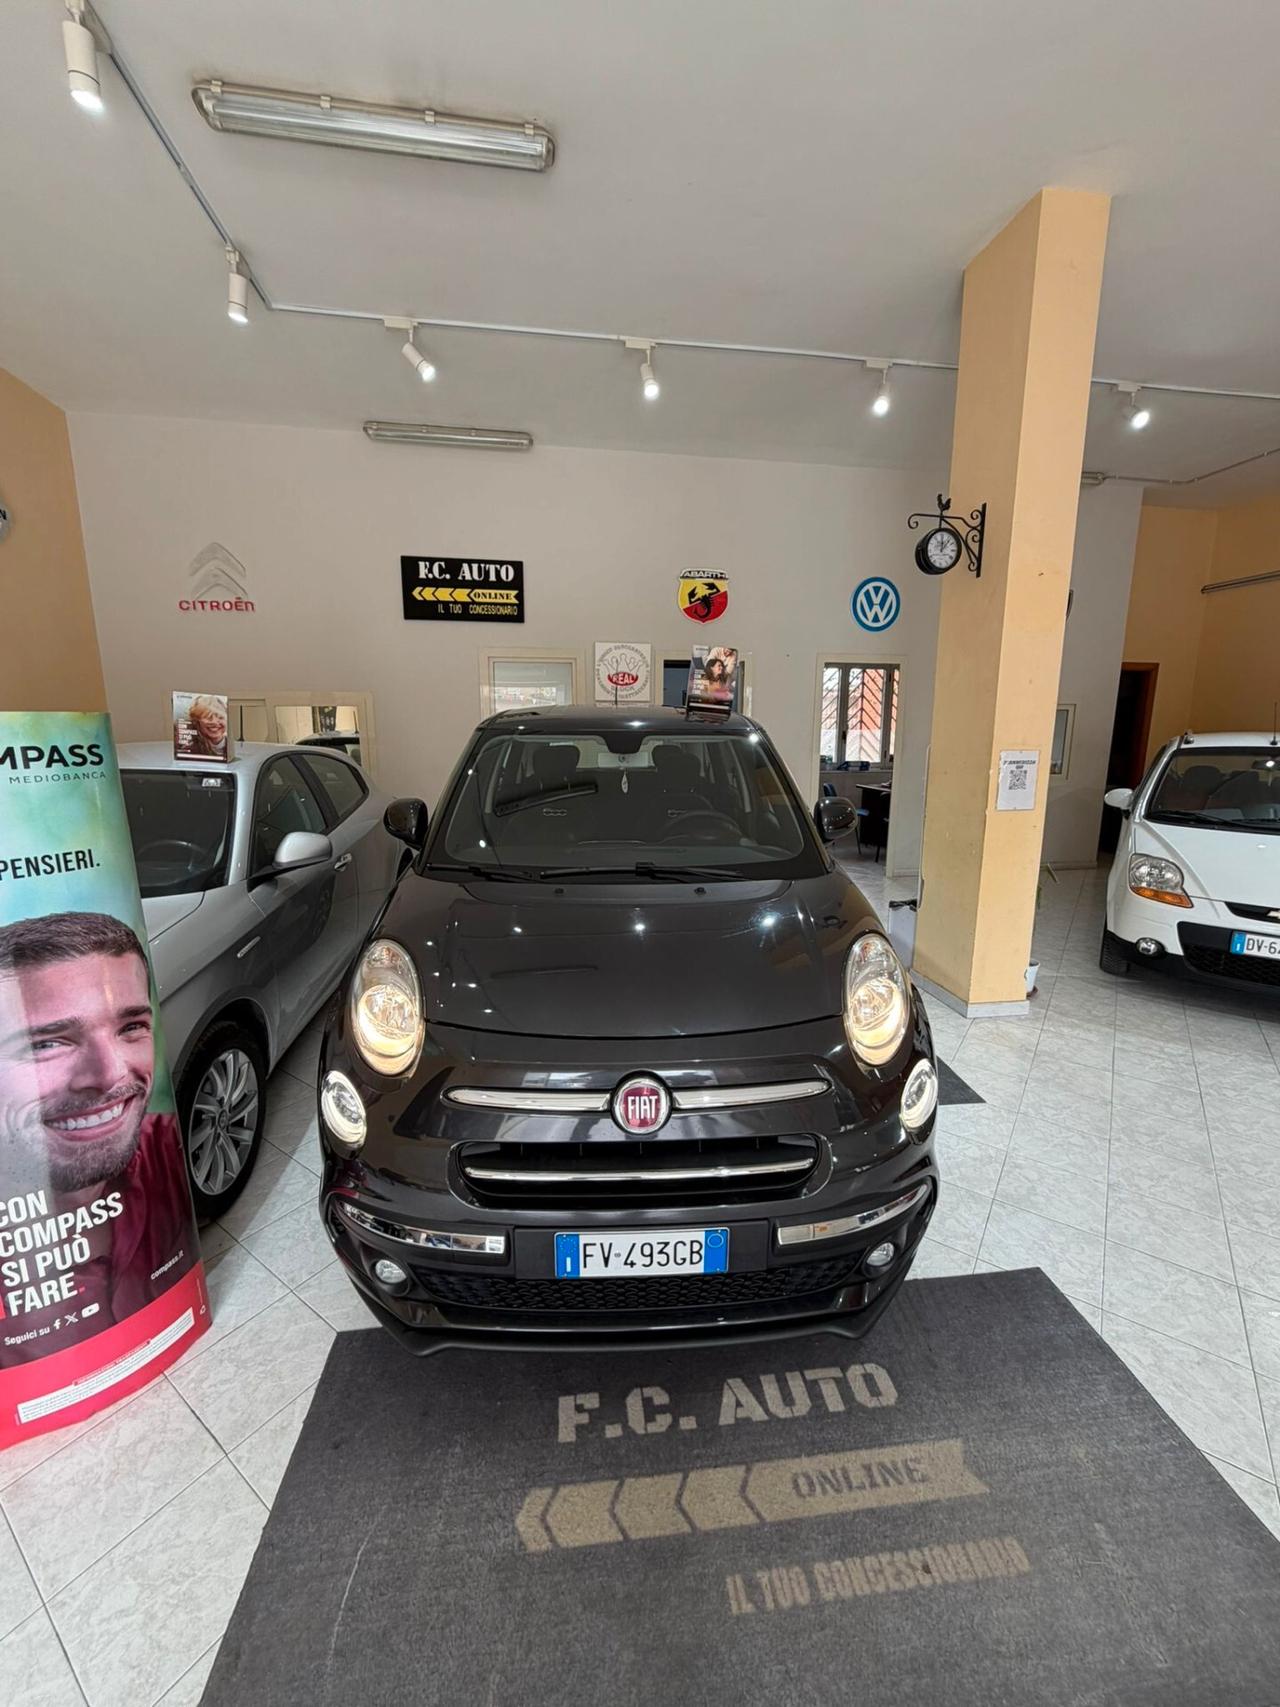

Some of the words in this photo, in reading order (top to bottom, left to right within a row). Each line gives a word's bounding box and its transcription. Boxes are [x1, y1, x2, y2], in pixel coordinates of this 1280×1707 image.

[417, 561, 451, 580] F.C.
[457, 563, 515, 582] AUTO
[683, 570, 726, 579] ABARTH
[473, 591, 513, 601] ONLINE
[437, 603, 445, 614] IL
[449, 604, 463, 614] TUO
[469, 605, 518, 616] CONCESSIONARIO
[9, 771, 107, 784] MEDIOBANCA
[627, 1095, 658, 1120] FIAT
[0, 1192, 123, 1258] COMPASS
[1, 1258, 29, 1287] SI
[35, 1233, 91, 1278] PUÒ
[7, 1272, 86, 1317] FARE.
[4, 1331, 37, 1346] Seguici
[39, 1326, 50, 1336] su
[558, 1386, 697, 1443] F.C.
[718, 1363, 899, 1426] AUTO
[791, 1457, 928, 1500] ONLINE
[757, 1565, 811, 1612] TUO
